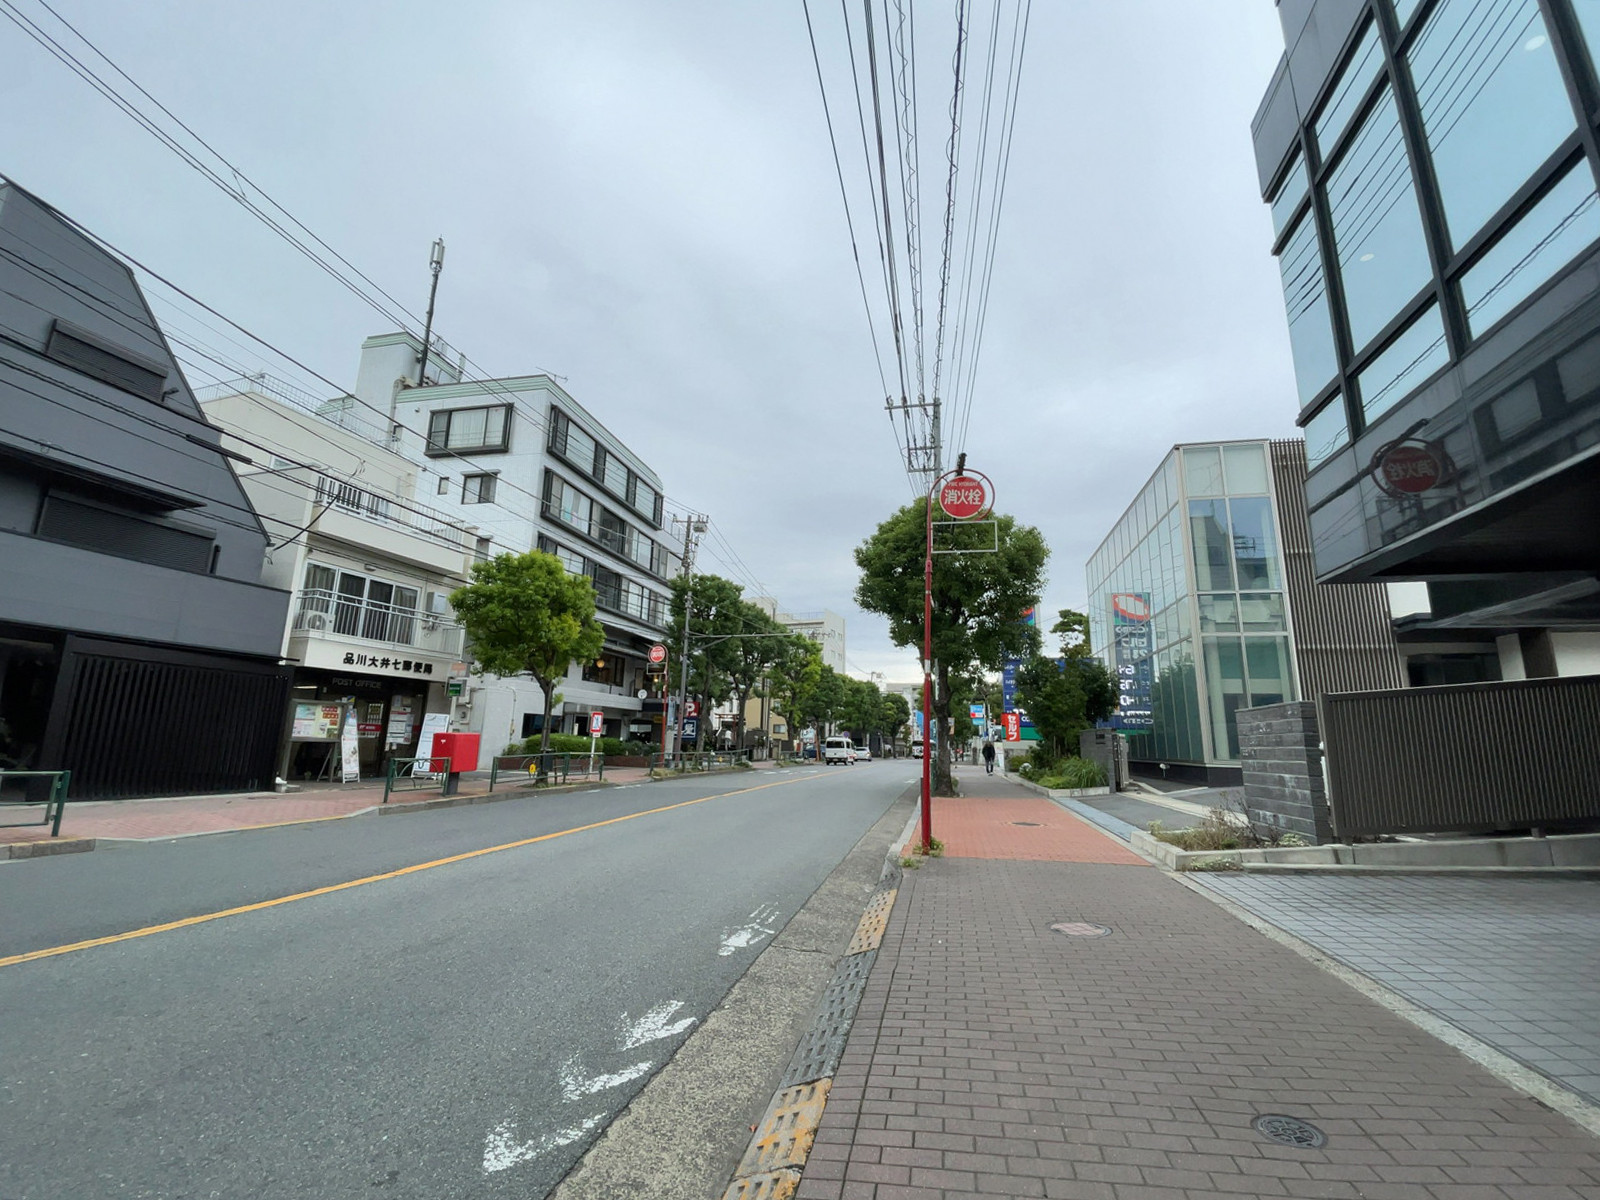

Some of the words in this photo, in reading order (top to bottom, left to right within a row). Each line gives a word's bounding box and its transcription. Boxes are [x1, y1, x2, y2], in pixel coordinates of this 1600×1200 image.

[944, 488, 982, 505] 消火栓
[343, 652, 433, 675] 品川大井七郵便局
[332, 677, 353, 686] POST
[355, 679, 382, 689] OFFICE
[1007, 715, 1017, 741] セルフ
